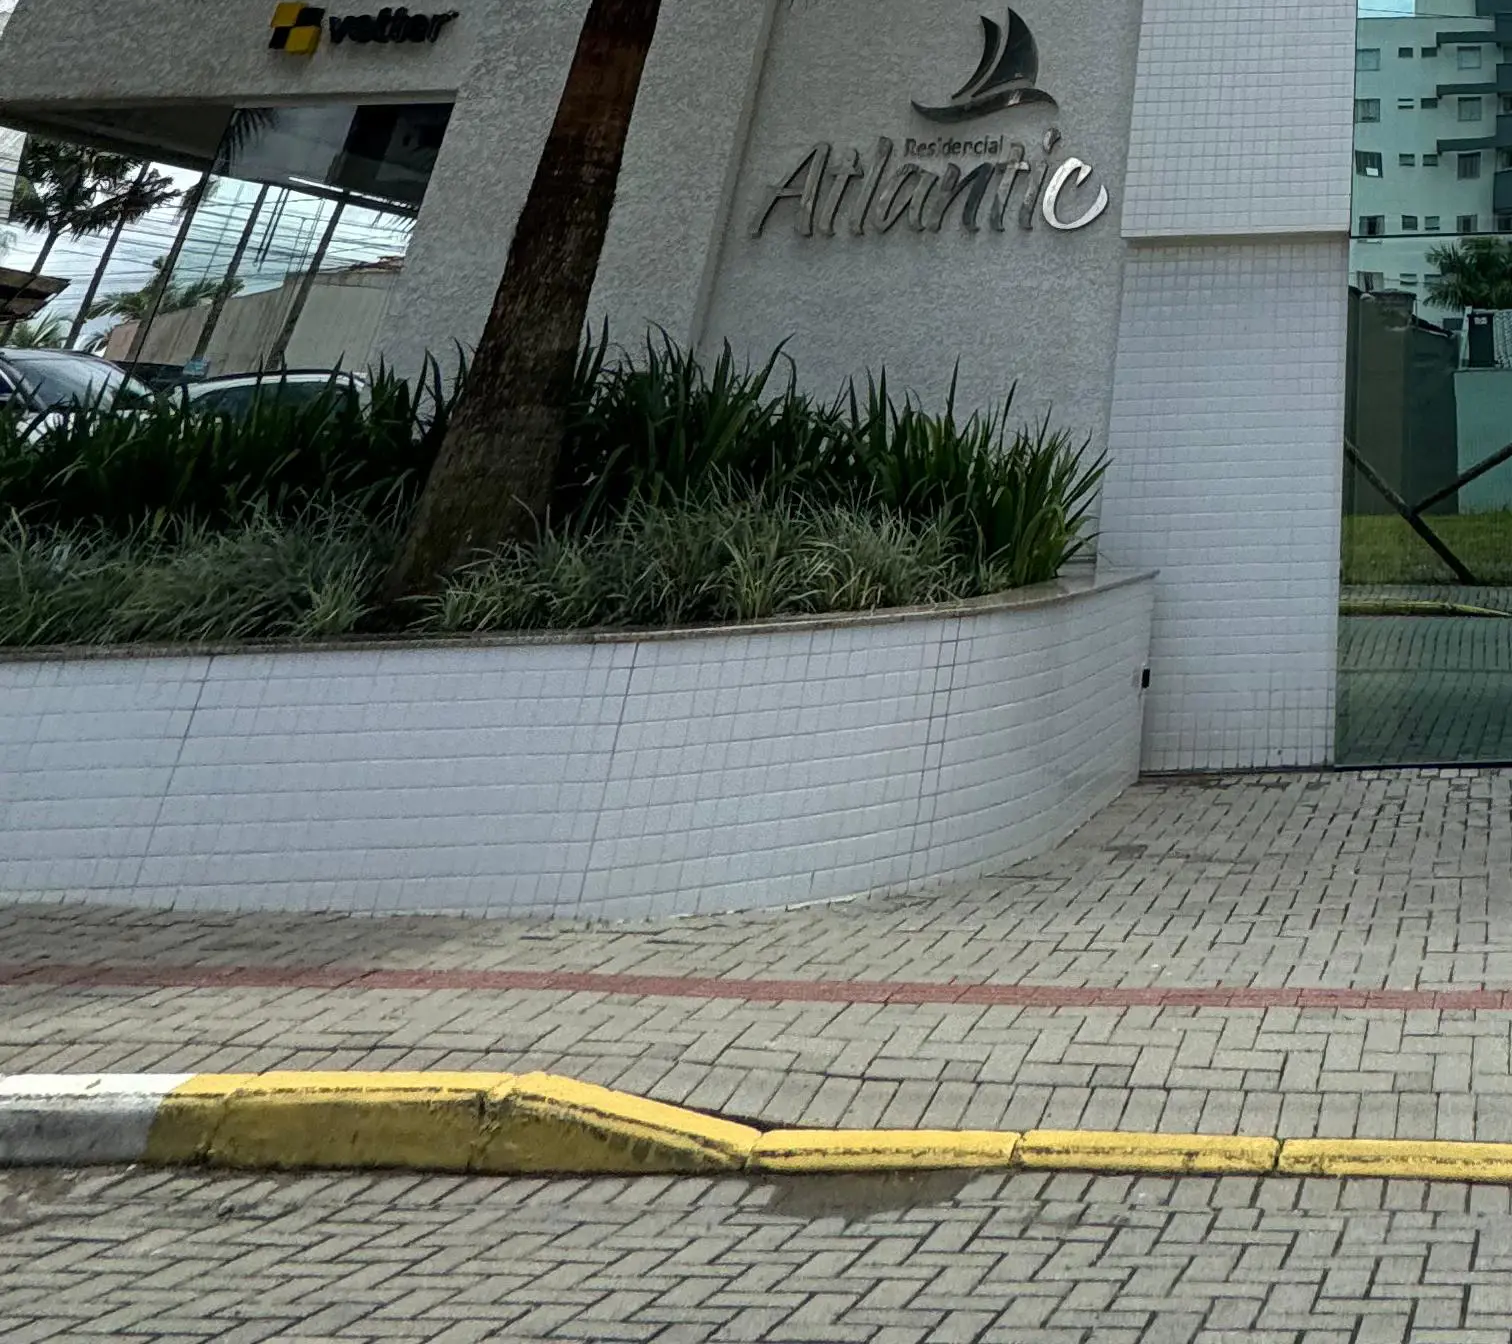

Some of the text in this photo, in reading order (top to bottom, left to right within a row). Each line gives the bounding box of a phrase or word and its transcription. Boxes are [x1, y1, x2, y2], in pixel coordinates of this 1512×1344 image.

[329, 6, 453, 43] vetter
[904, 133, 1005, 158] Residencial
[751, 128, 1109, 240] Atlantic
